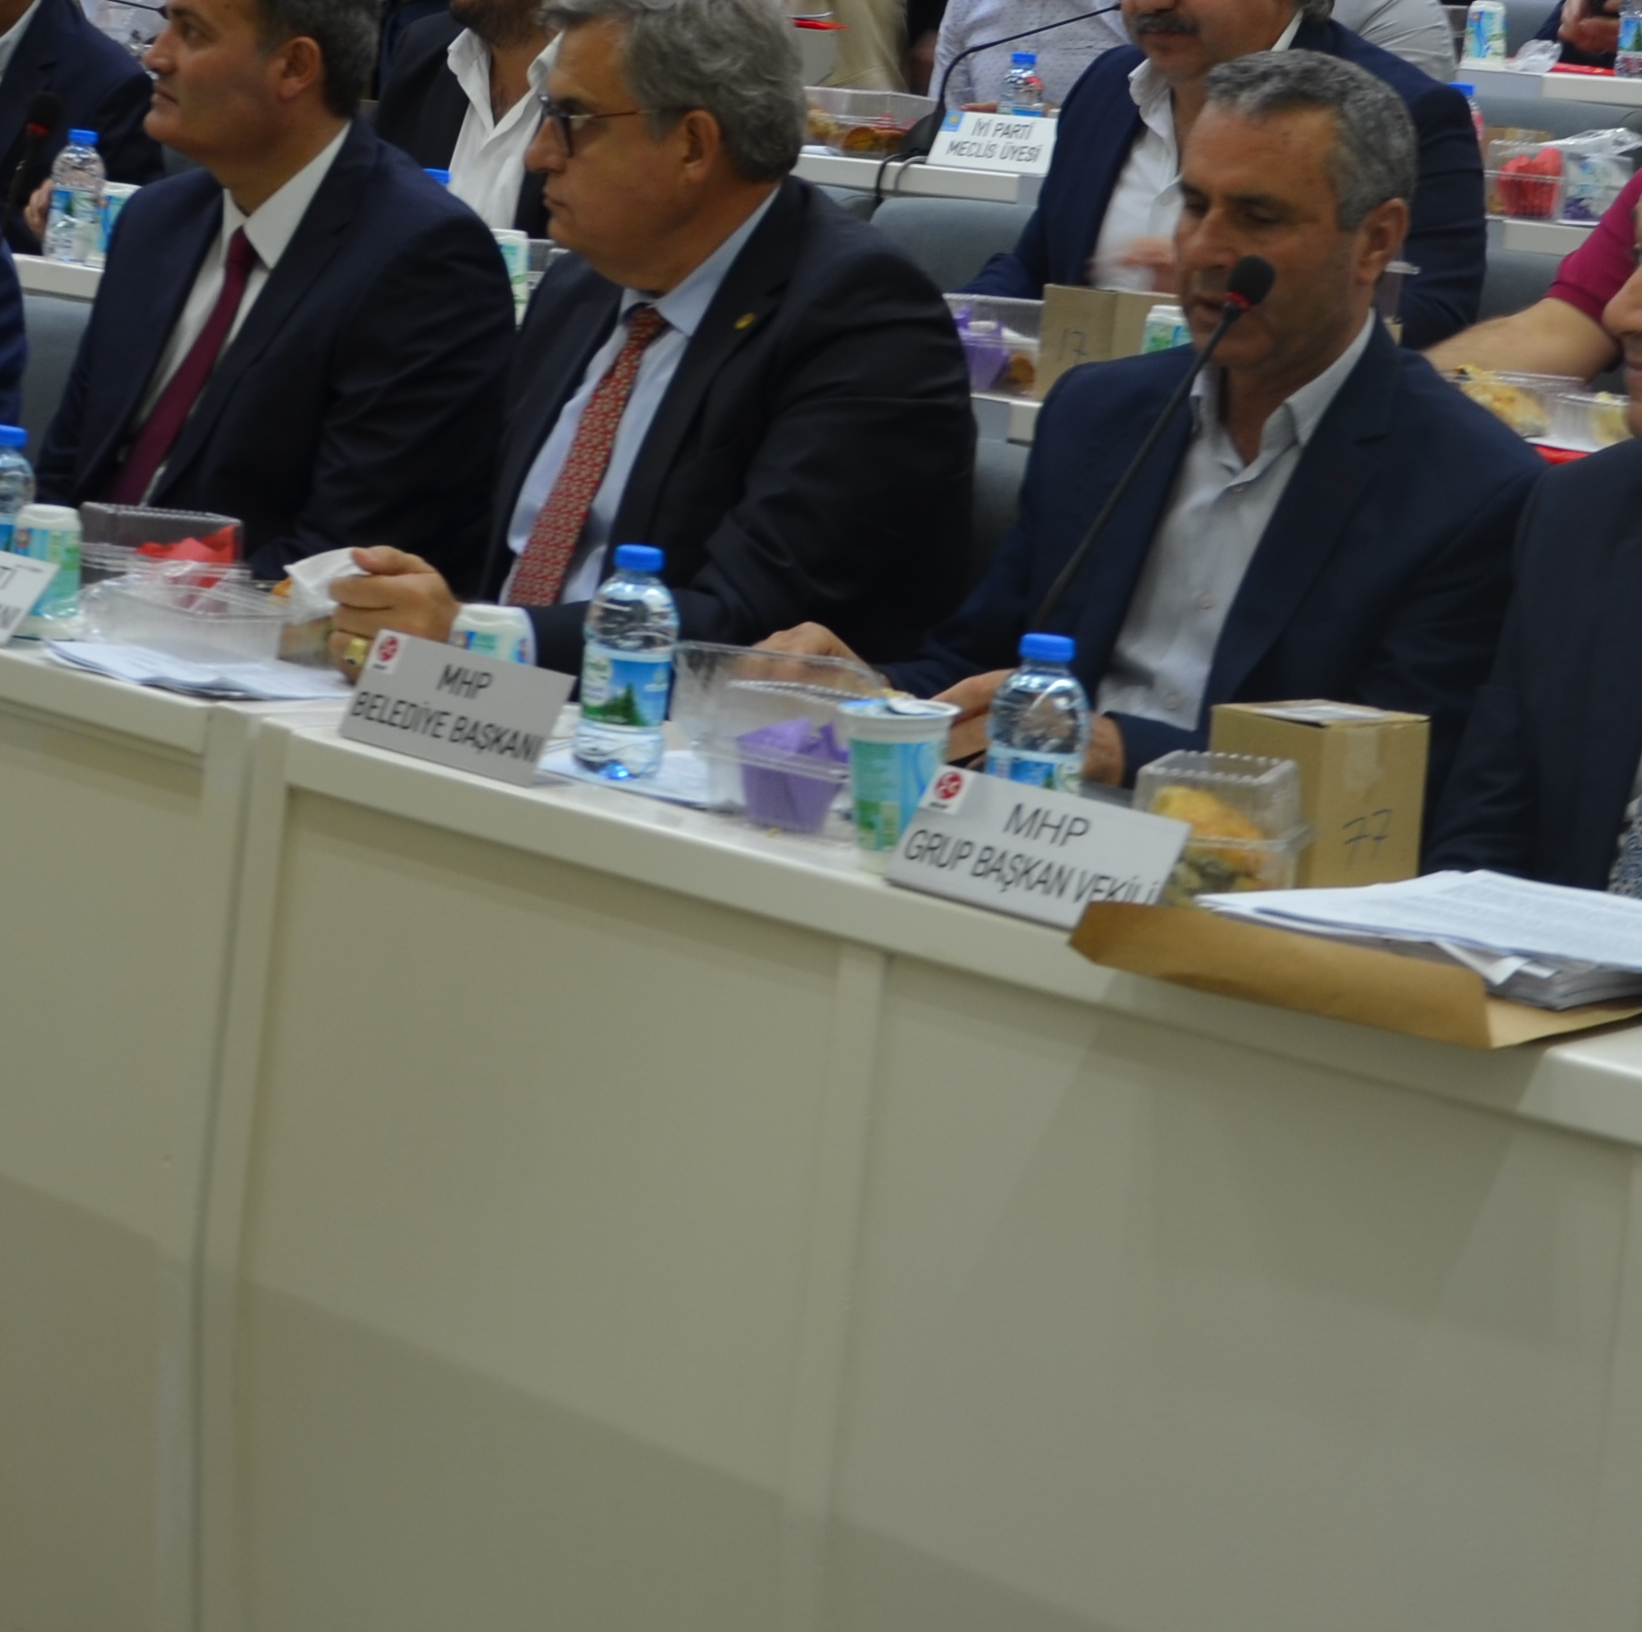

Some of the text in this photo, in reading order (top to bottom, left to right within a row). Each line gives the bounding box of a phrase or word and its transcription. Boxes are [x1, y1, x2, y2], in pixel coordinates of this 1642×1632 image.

[970, 117, 1036, 141] İYİ PARTİ
[945, 139, 1044, 164] MECLİS ÜYESİ
[436, 663, 495, 700] MHP
[350, 690, 547, 764] BELEDİYE BAŞKANI
[1002, 802, 1092, 848] MHP
[904, 828, 974, 870] GRUP
[970, 844, 1077, 900] BAŞKAN
